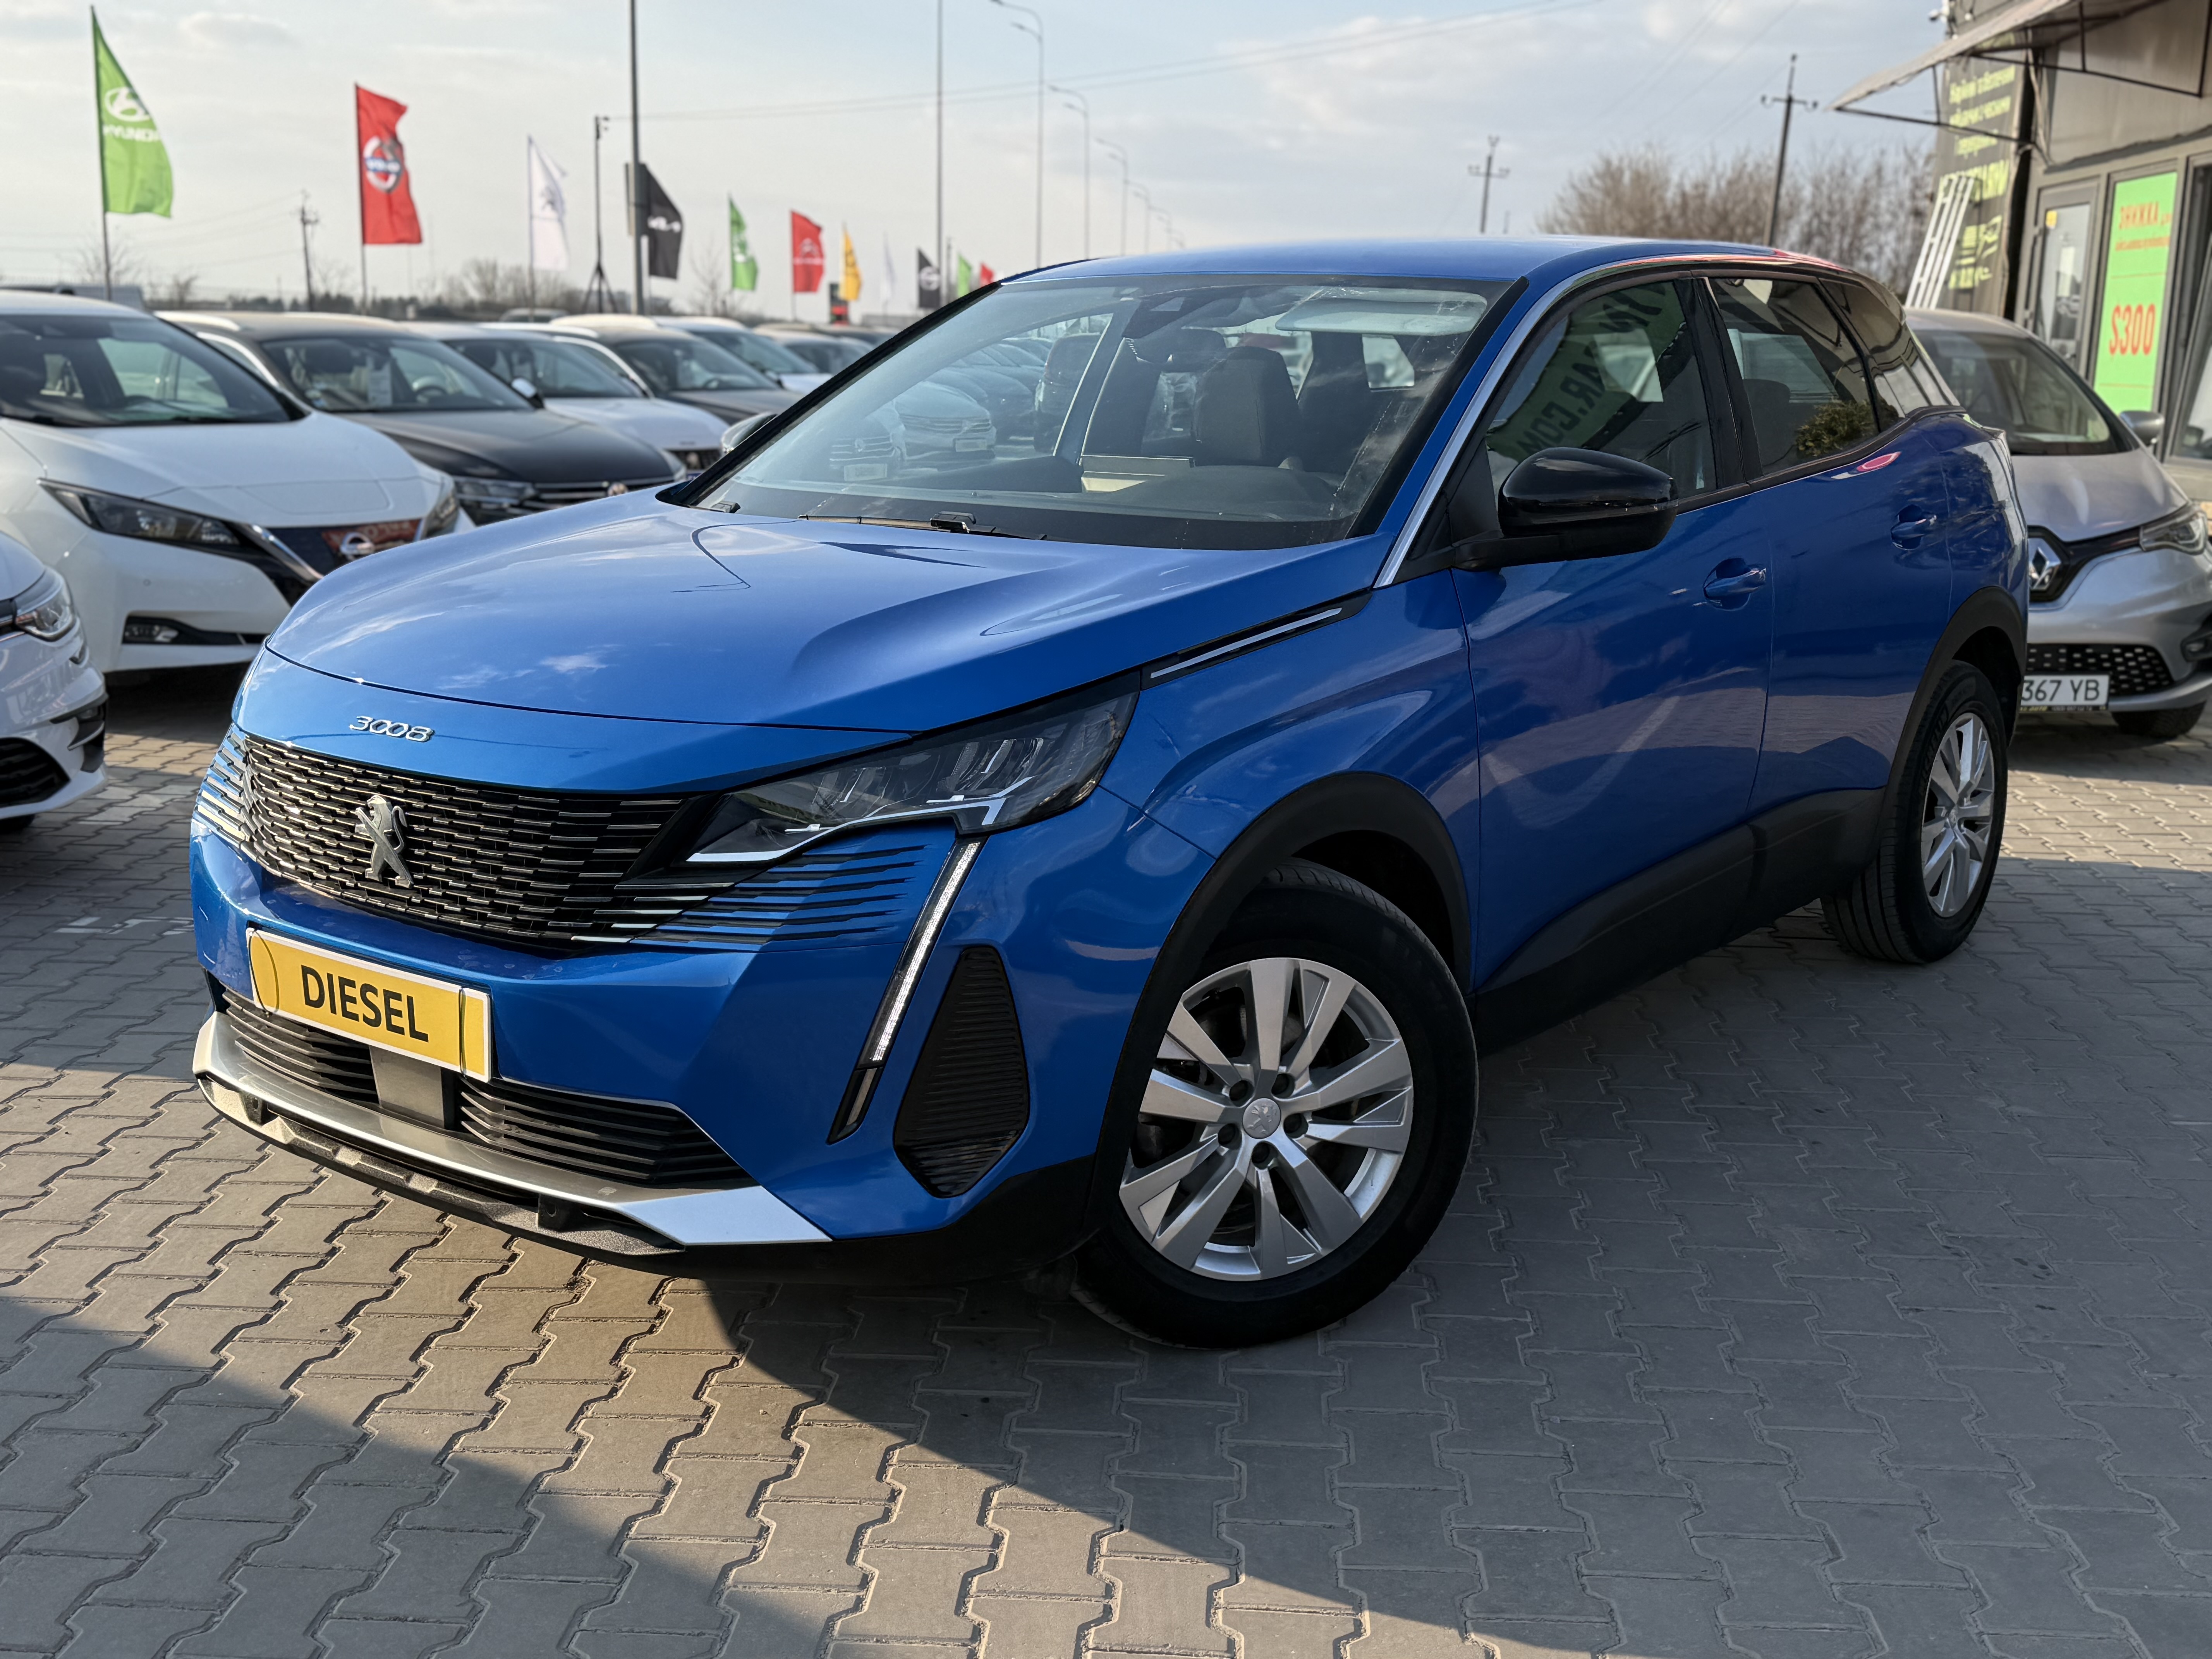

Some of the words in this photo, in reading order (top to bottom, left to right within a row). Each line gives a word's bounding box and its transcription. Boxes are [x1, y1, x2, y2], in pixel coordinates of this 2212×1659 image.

[2070, 679, 2099, 701] YB
[349, 716, 434, 742] 3008
[301, 965, 428, 1042] DIESEL
